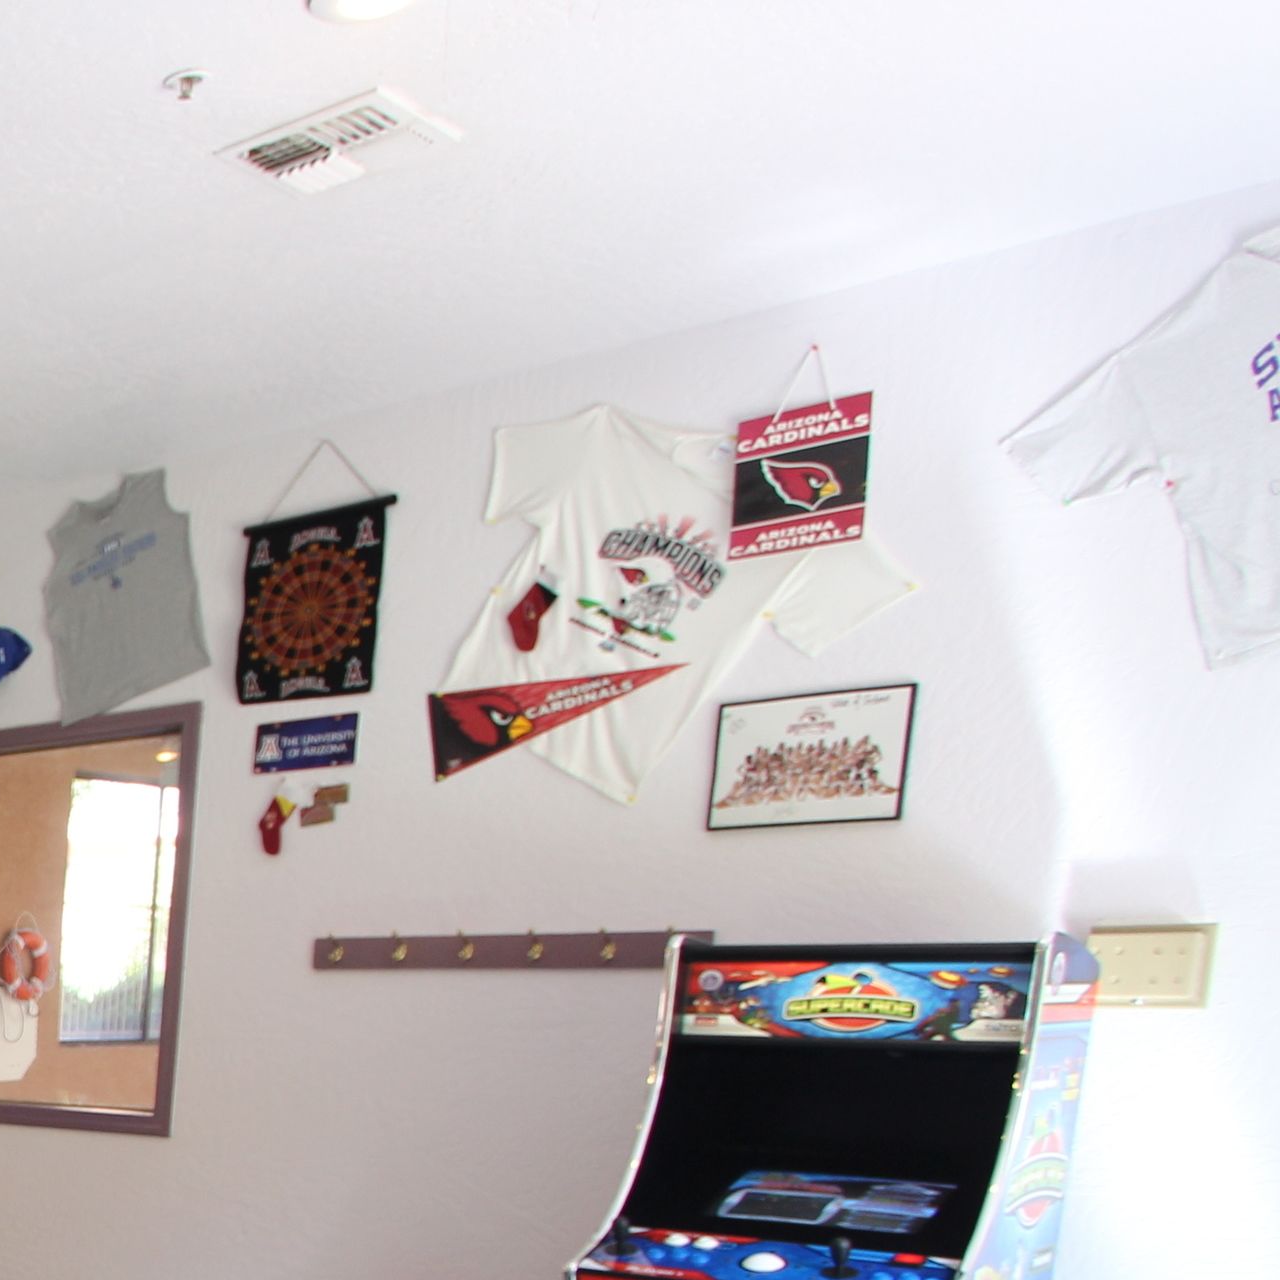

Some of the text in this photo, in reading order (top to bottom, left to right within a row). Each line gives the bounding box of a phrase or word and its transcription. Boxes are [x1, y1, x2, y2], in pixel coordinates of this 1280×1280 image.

[737, 414, 870, 453] CARDINALS
[763, 410, 843, 436] ARIZONA
[729, 525, 861, 558] CARDINALS
[755, 520, 835, 543] ARIZONA
[598, 527, 724, 598] CHAMPIONS
[524, 679, 634, 720] CARDINALS
[544, 677, 612, 702] ARIZONA
[282, 736, 299, 748] THE
[286, 743, 348, 759] OF ARIZONA
[788, 998, 915, 1019] SUPERCADE
